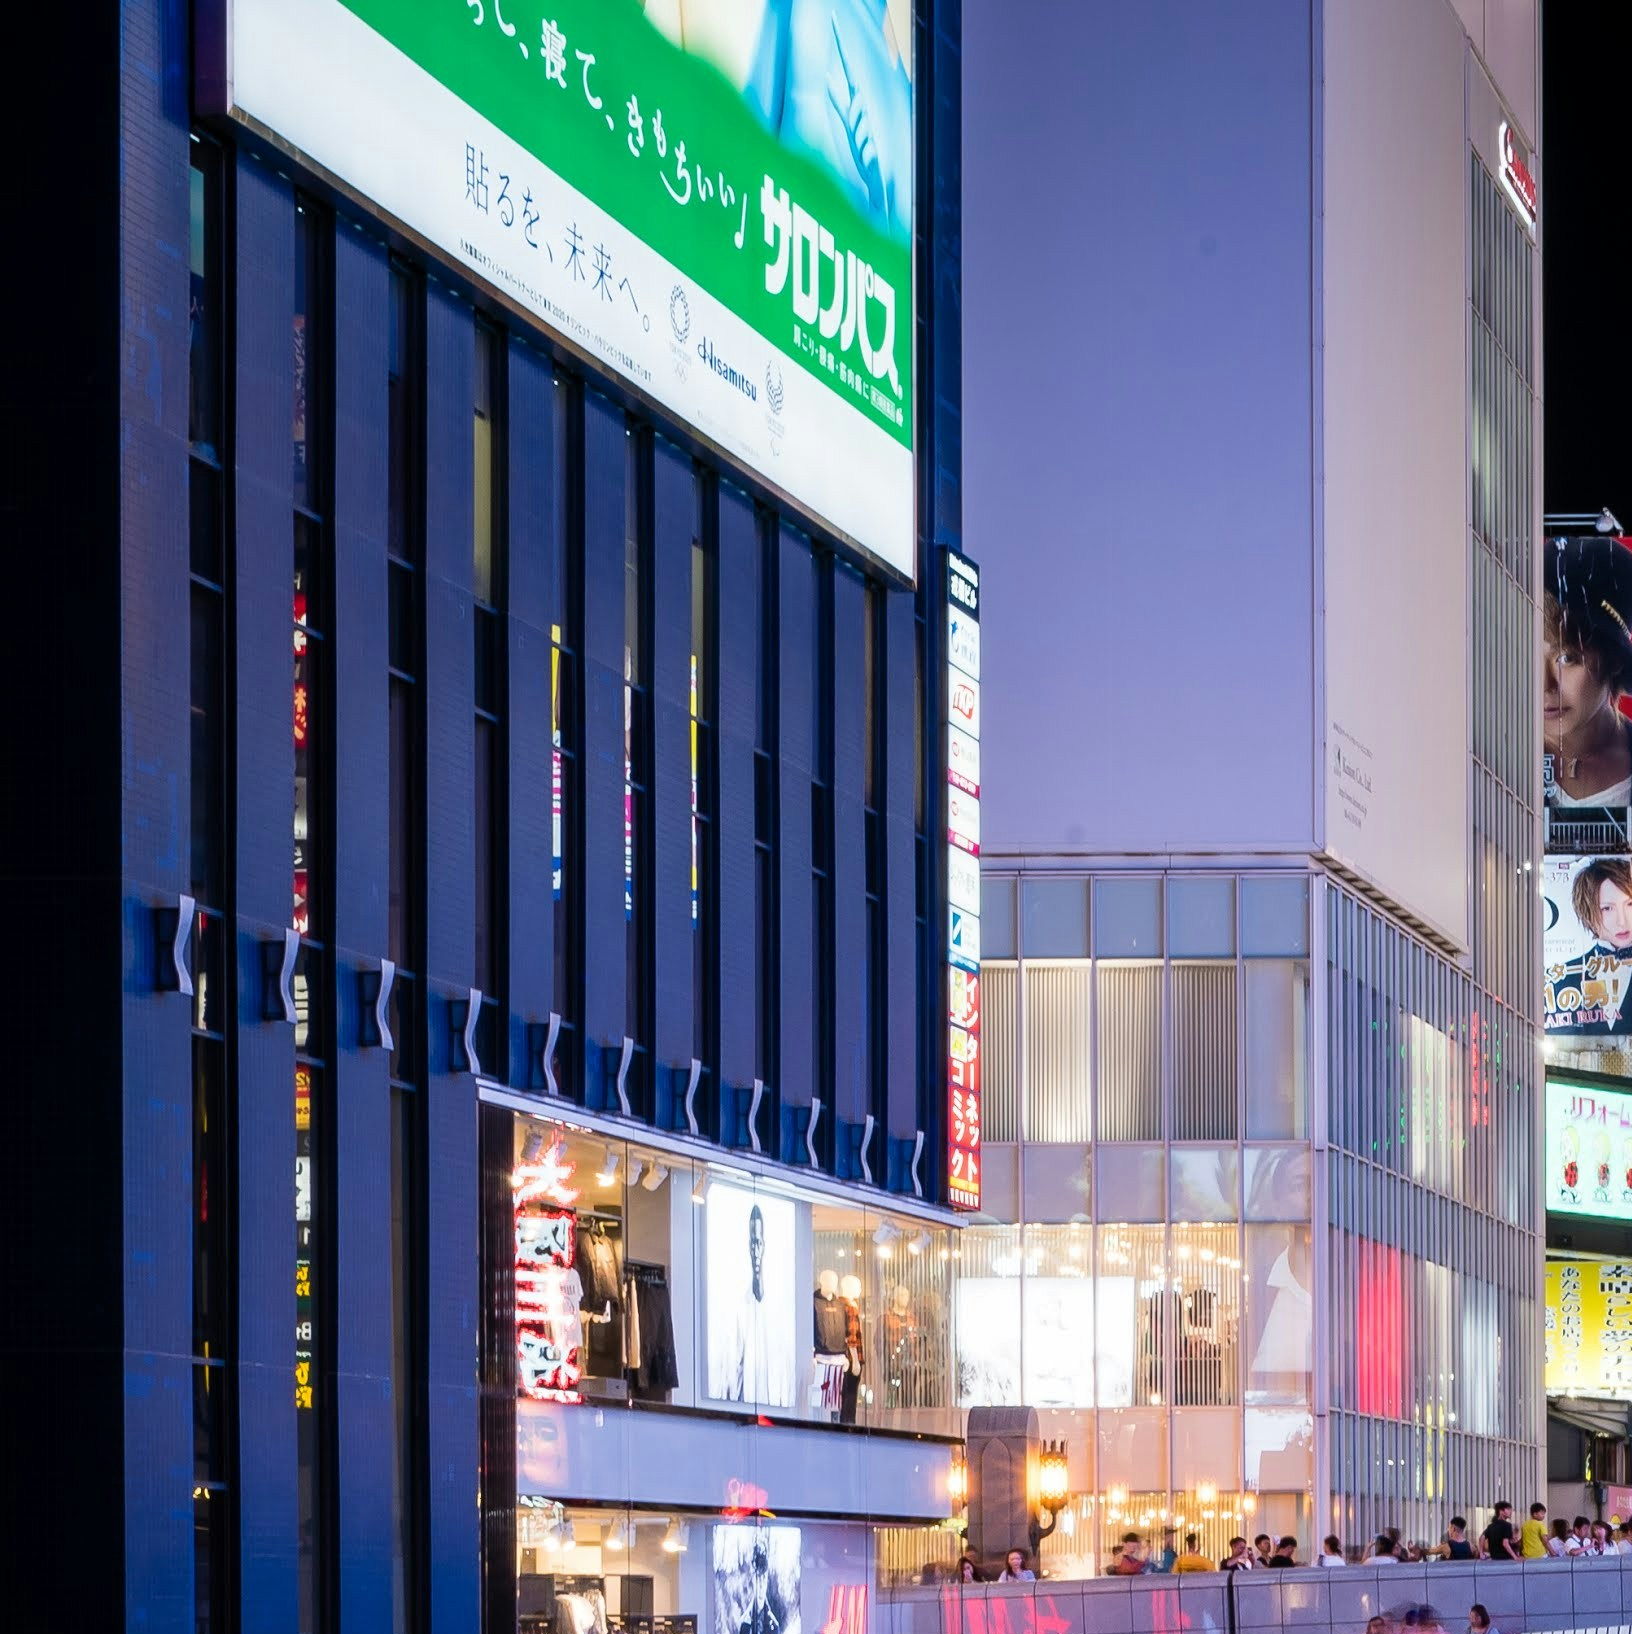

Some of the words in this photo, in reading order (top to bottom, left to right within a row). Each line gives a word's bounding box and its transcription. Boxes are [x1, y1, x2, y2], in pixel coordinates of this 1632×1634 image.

[465, 142, 651, 334] 貼るを、未来へ。
[697, 336, 757, 401] Hisamitsu
[1570, 1095, 1632, 1128] リフォーム
